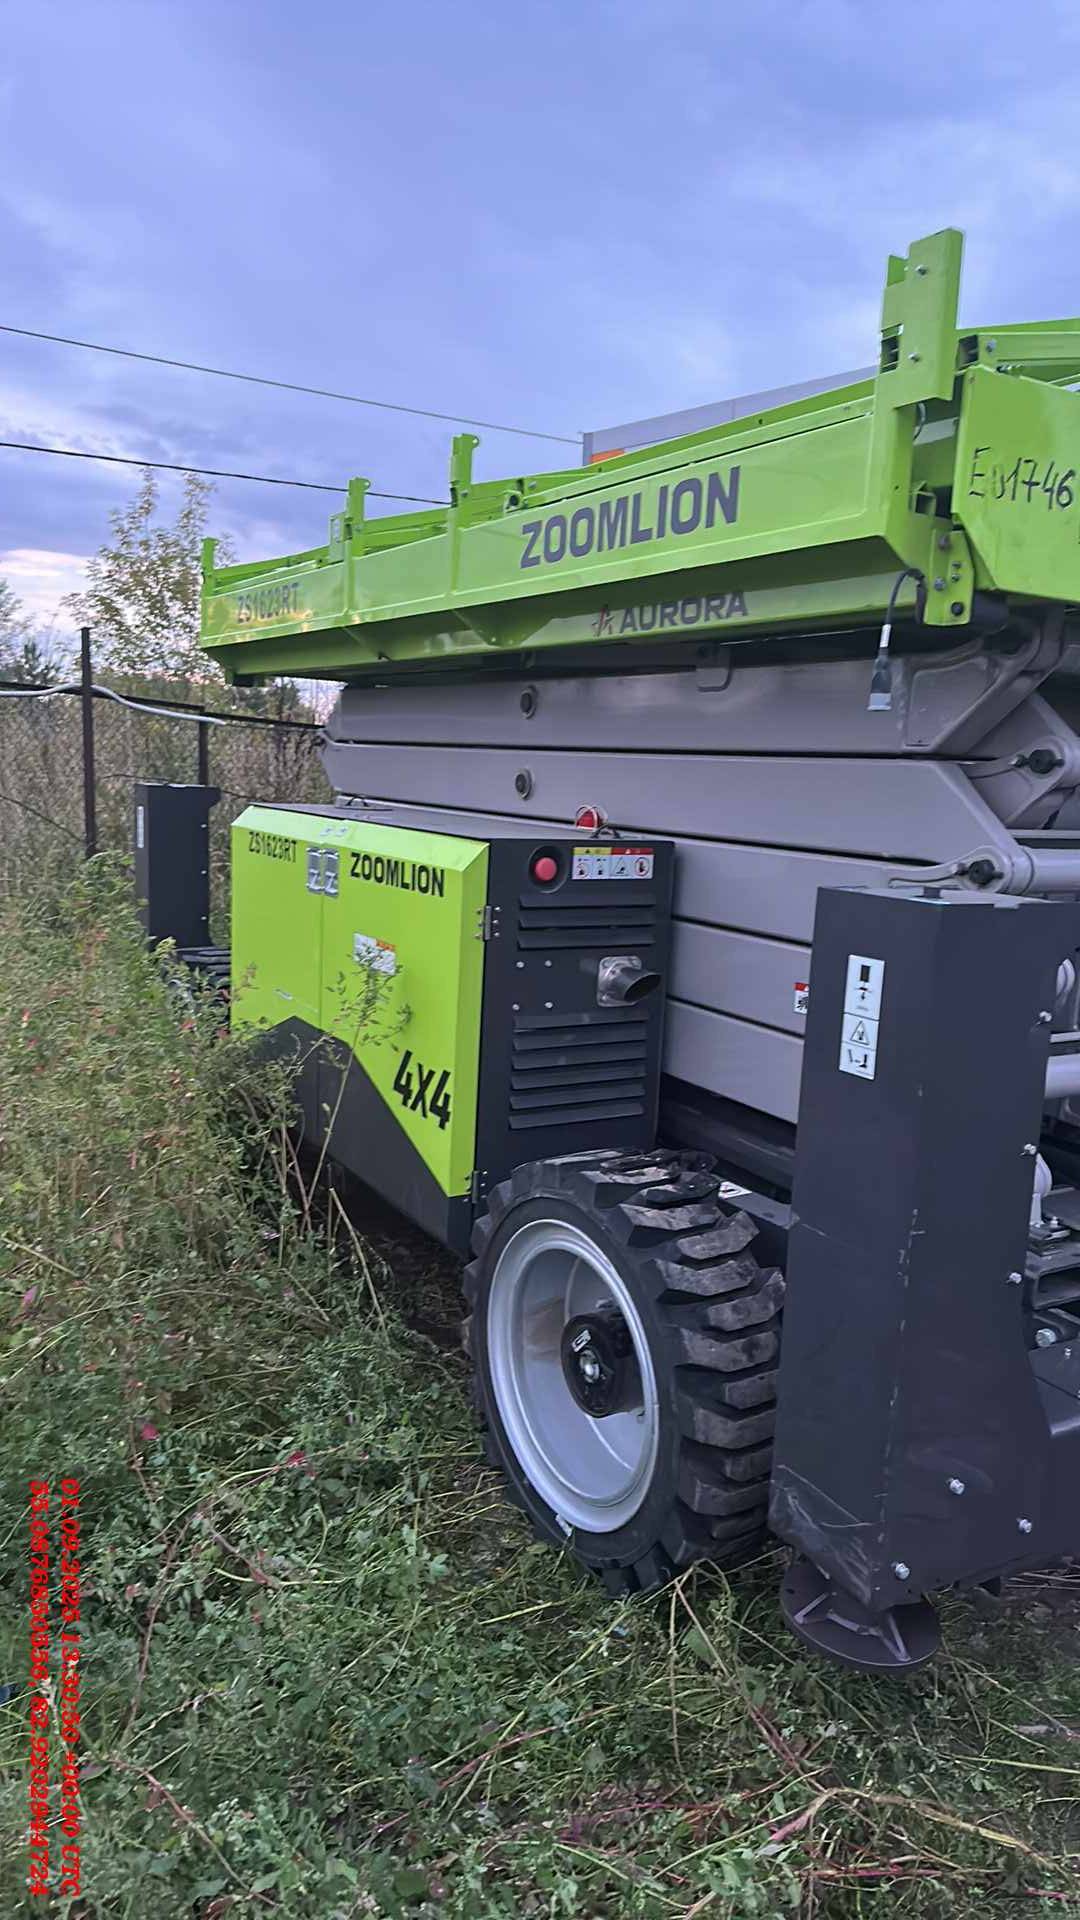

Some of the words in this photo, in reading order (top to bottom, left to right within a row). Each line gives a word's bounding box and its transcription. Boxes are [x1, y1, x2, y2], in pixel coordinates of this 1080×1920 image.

[520, 466, 742, 569] ZOOMLION
[619, 592, 749, 633] AURORA
[248, 830, 297, 864] ZS1623RT
[349, 852, 446, 898] ZOOMLION
[393, 1050, 452, 1131] 4X4
